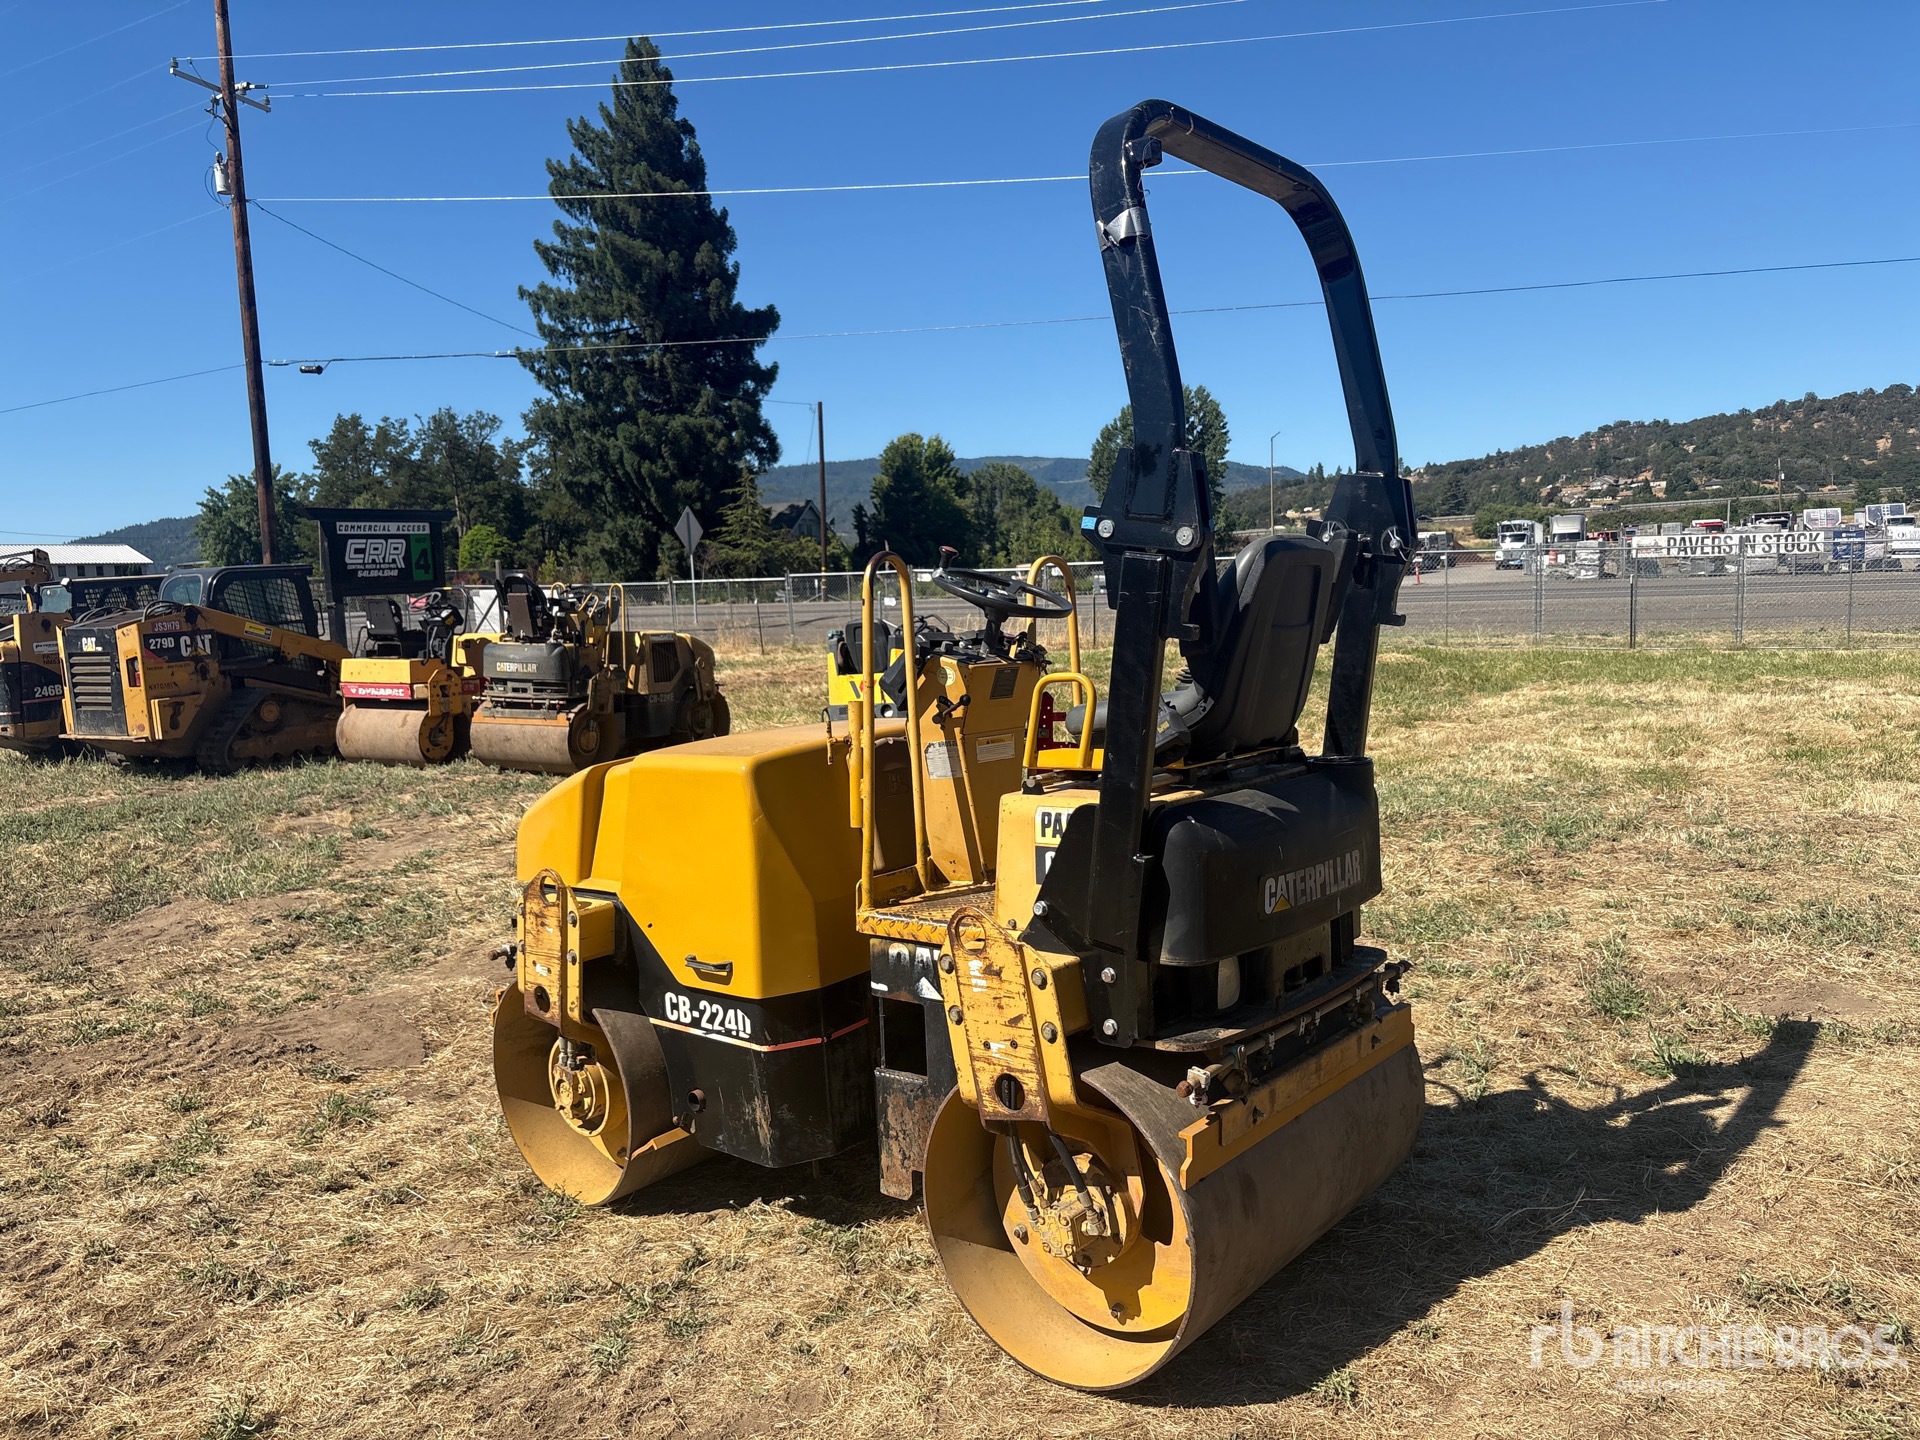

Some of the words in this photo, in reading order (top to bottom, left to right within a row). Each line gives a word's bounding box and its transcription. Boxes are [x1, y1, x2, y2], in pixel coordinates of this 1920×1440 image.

[338, 524, 391, 533] COMMERCIAL
[396, 524, 427, 533] ACCESS
[344, 538, 406, 569] CRR
[1666, 536, 1734, 556] PAVERS
[1762, 531, 1821, 554] STOCK
[414, 548, 432, 575] 4
[154, 620, 180, 632] JS3H79
[81, 637, 97, 652] CAT
[149, 637, 175, 650] 279D
[496, 661, 538, 673] CATERPILLAR
[34, 684, 63, 698] 246B
[1041, 811, 1073, 839] PA
[1264, 849, 1362, 915] CATERPILLAR
[664, 991, 752, 1040] CB-224D
